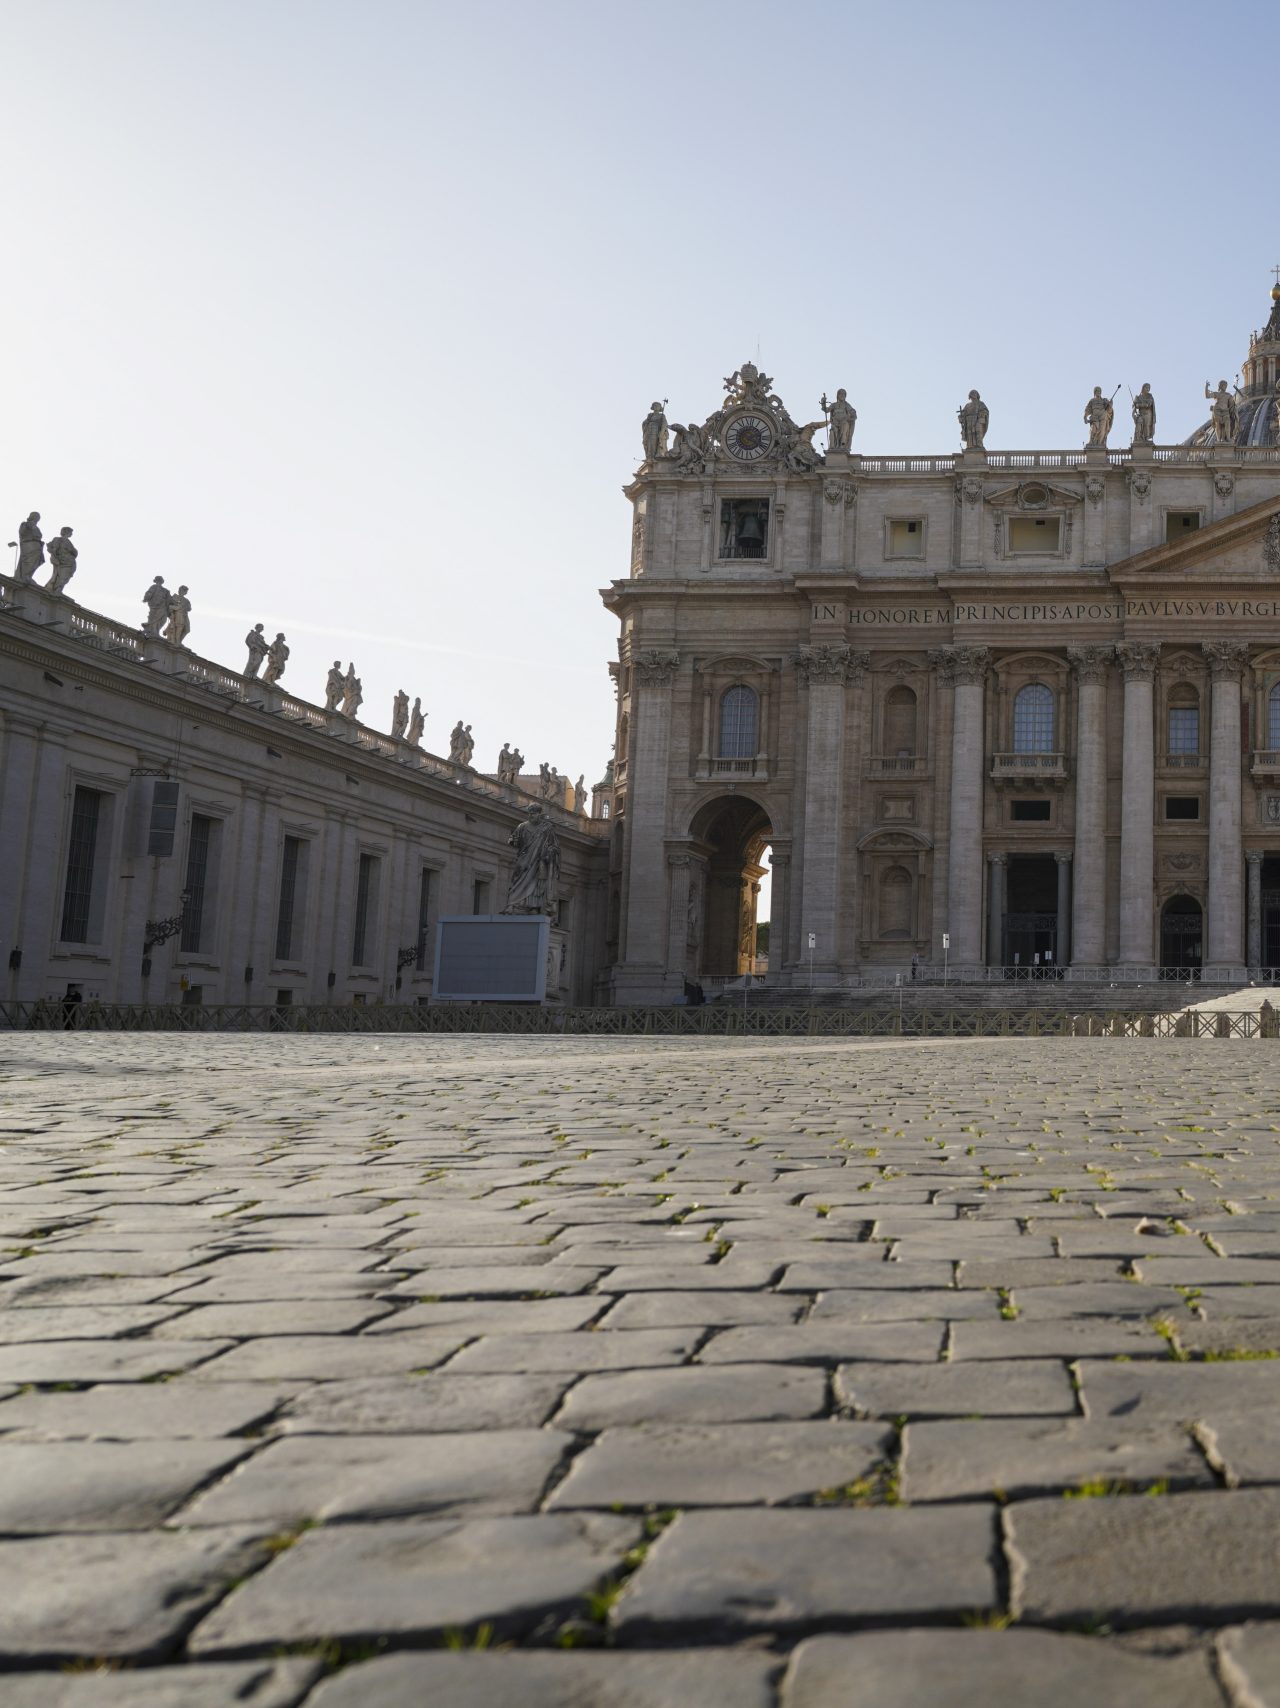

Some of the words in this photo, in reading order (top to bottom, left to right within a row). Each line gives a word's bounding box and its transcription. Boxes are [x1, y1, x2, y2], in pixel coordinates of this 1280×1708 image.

[813, 605, 837, 620] IN
[849, 609, 950, 624] HONOREM
[955, 605, 1057, 620] PRINCIPIS
[1062, 604, 1124, 619] APOST
[1126, 601, 1194, 616] PAVLVS
